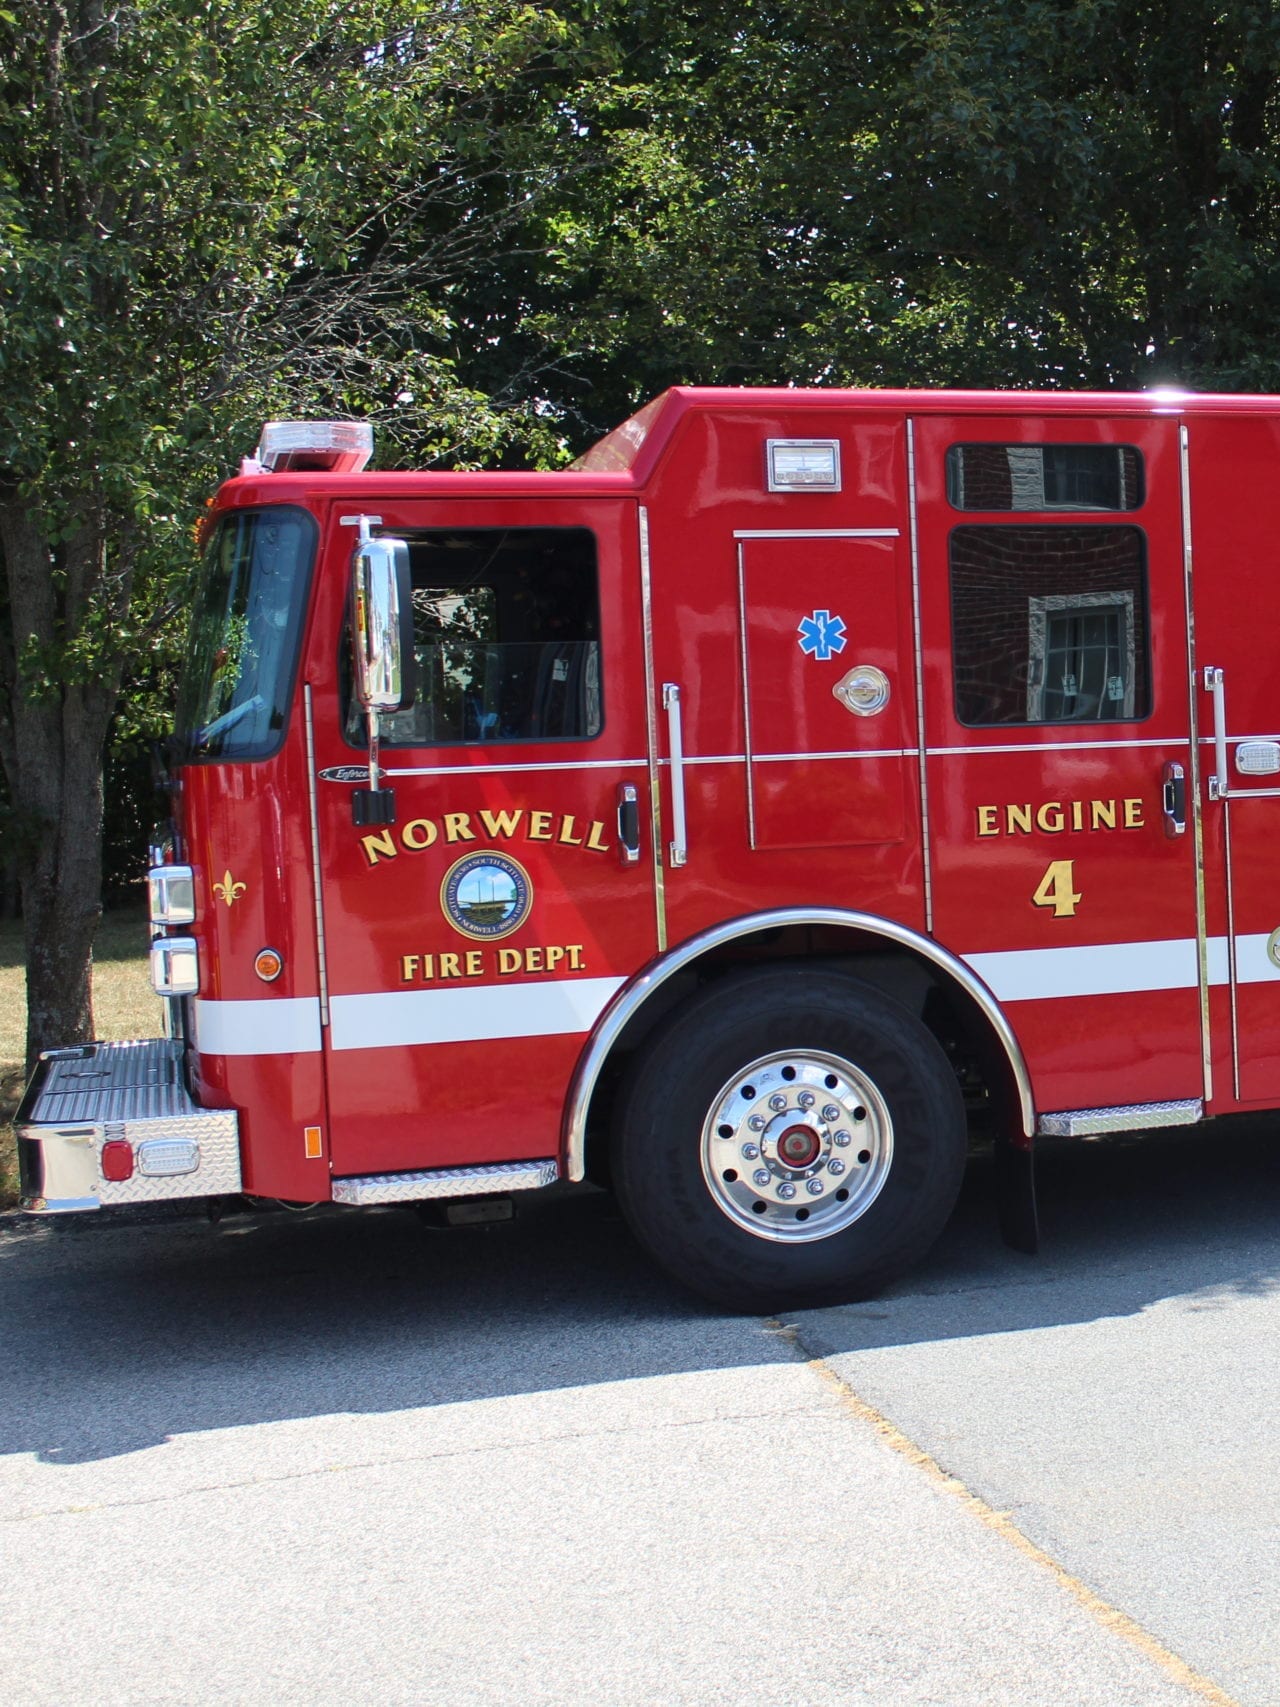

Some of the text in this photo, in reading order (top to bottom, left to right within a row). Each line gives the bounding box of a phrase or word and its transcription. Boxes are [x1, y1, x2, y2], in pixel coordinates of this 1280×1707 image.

[336, 768, 369, 781] Enforce
[976, 798, 1145, 836] ENGINE
[360, 808, 610, 865] NORWELL
[1031, 859, 1083, 918] 4
[402, 944, 586, 981] FIRE DEPT.
